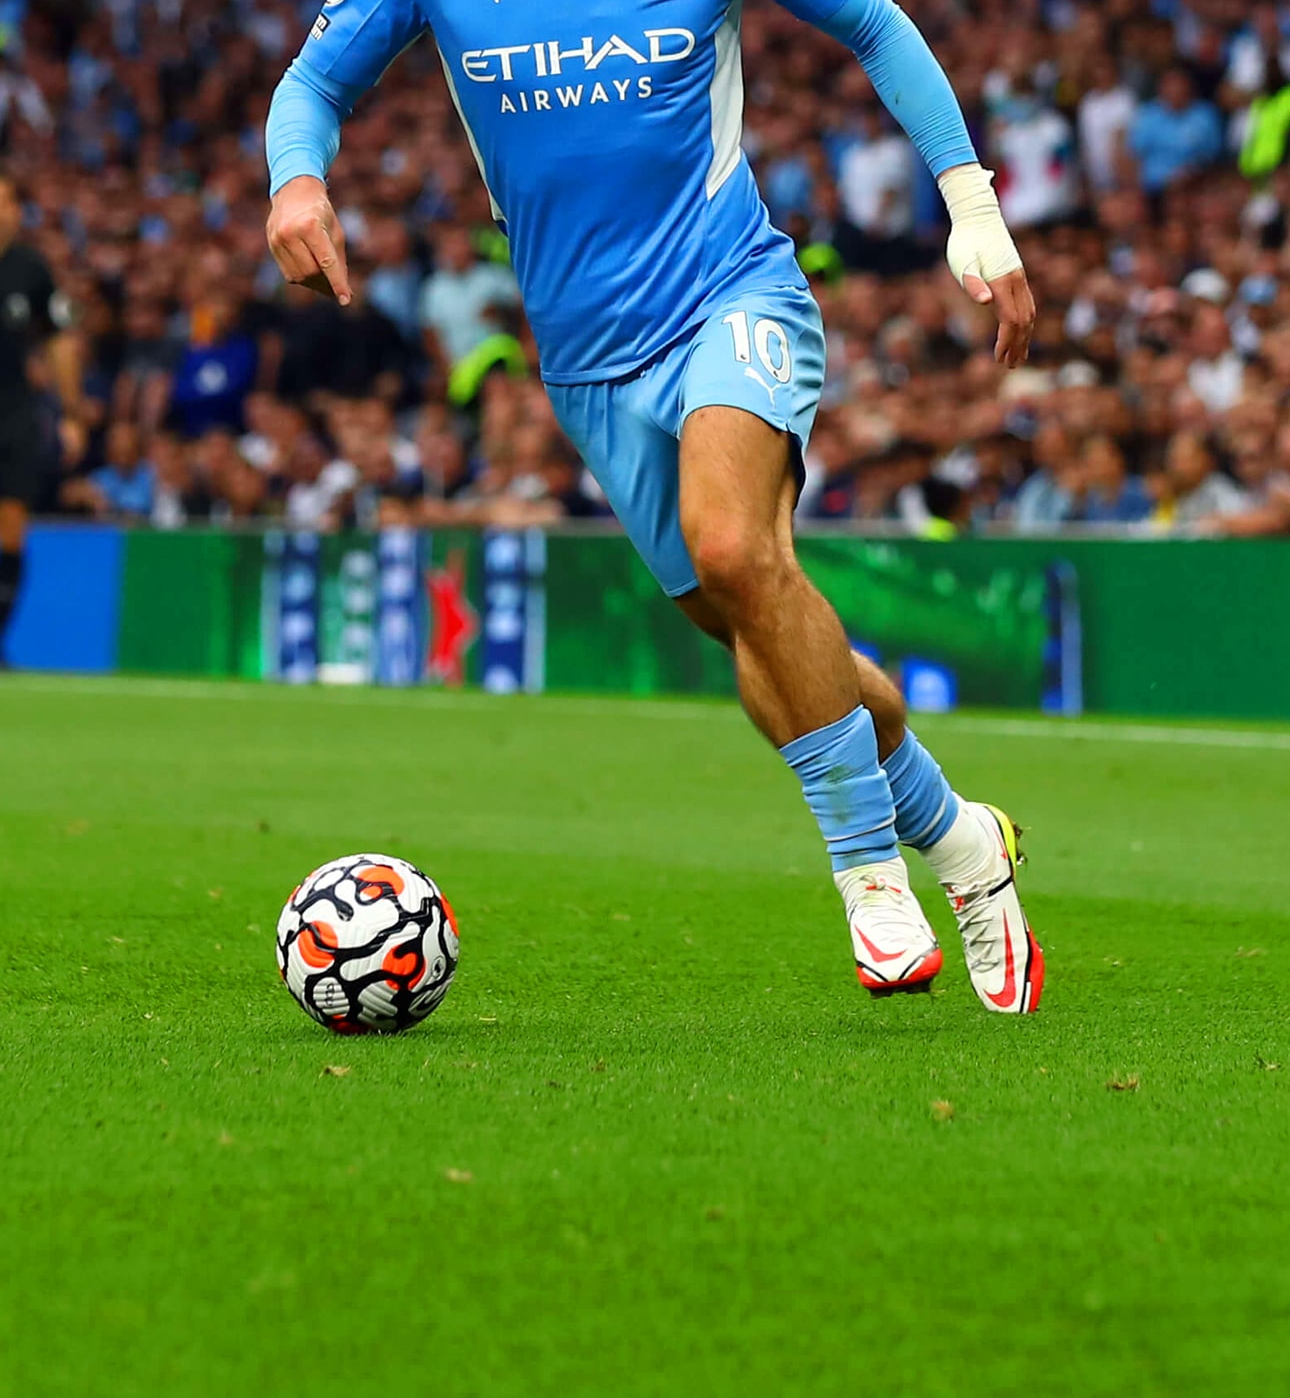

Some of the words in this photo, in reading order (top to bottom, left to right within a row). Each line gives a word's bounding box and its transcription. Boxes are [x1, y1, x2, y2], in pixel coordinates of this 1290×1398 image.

[461, 27, 696, 83] ETIHAD
[500, 76, 653, 114] AIRWAYS
[721, 310, 791, 384] 10
